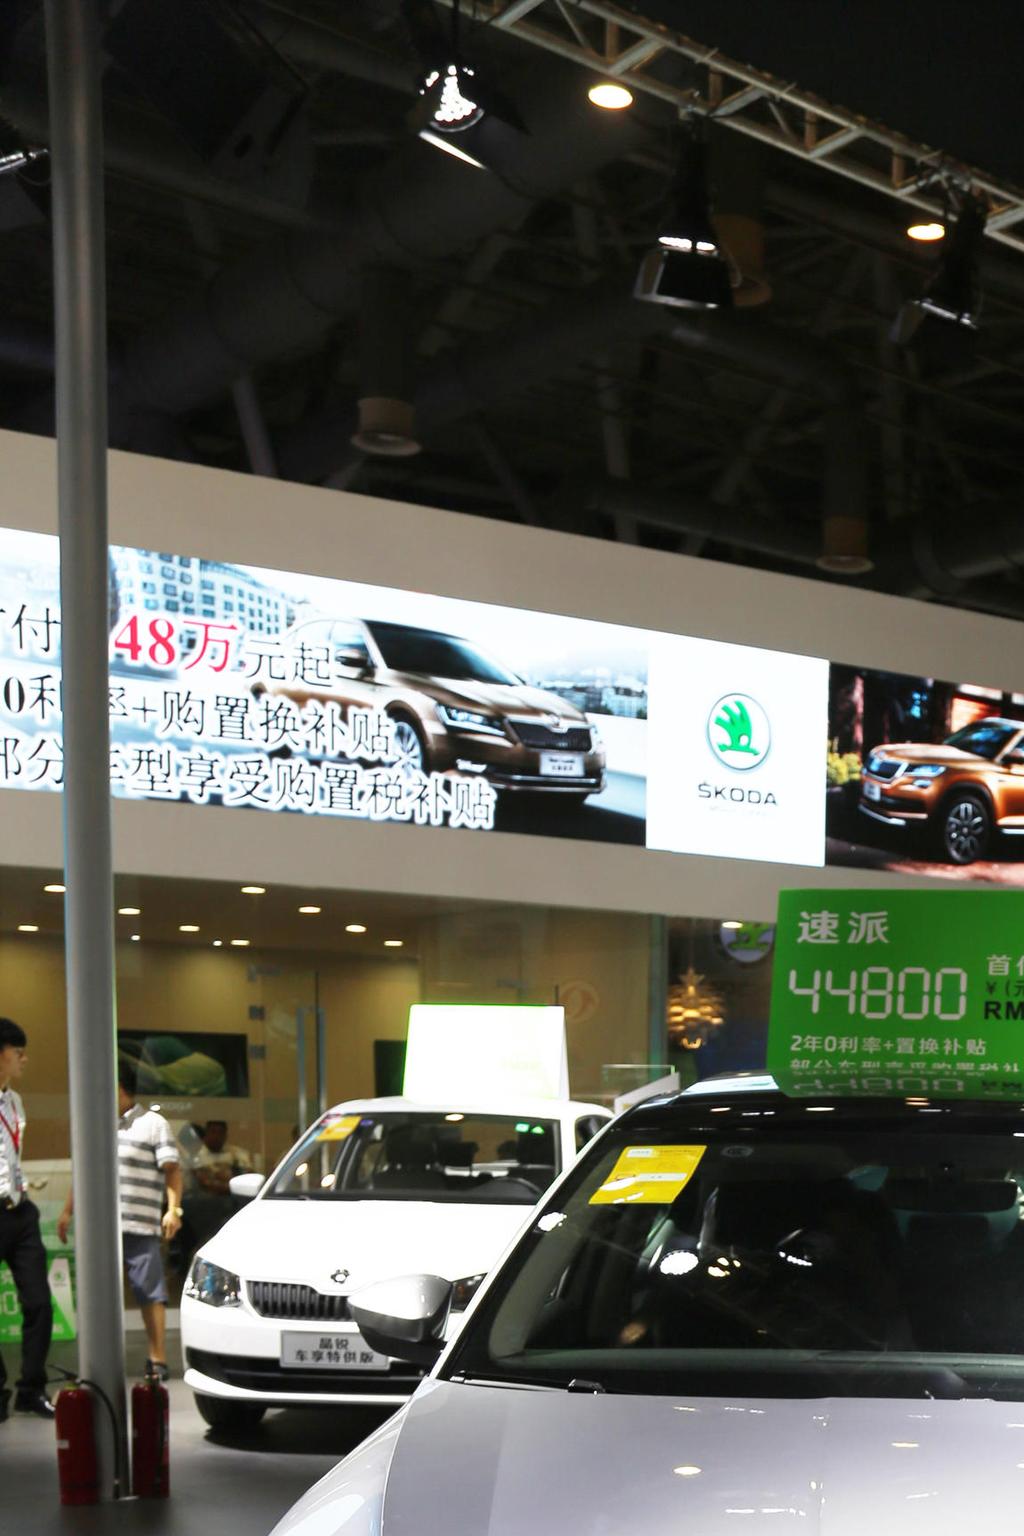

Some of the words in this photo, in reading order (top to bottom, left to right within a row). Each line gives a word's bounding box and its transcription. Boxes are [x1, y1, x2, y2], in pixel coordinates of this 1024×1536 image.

[796, 910, 890, 944] 速派
[788, 966, 968, 1021] 44800
[789, 1035, 987, 1056] 2年0利率+置换补贴
